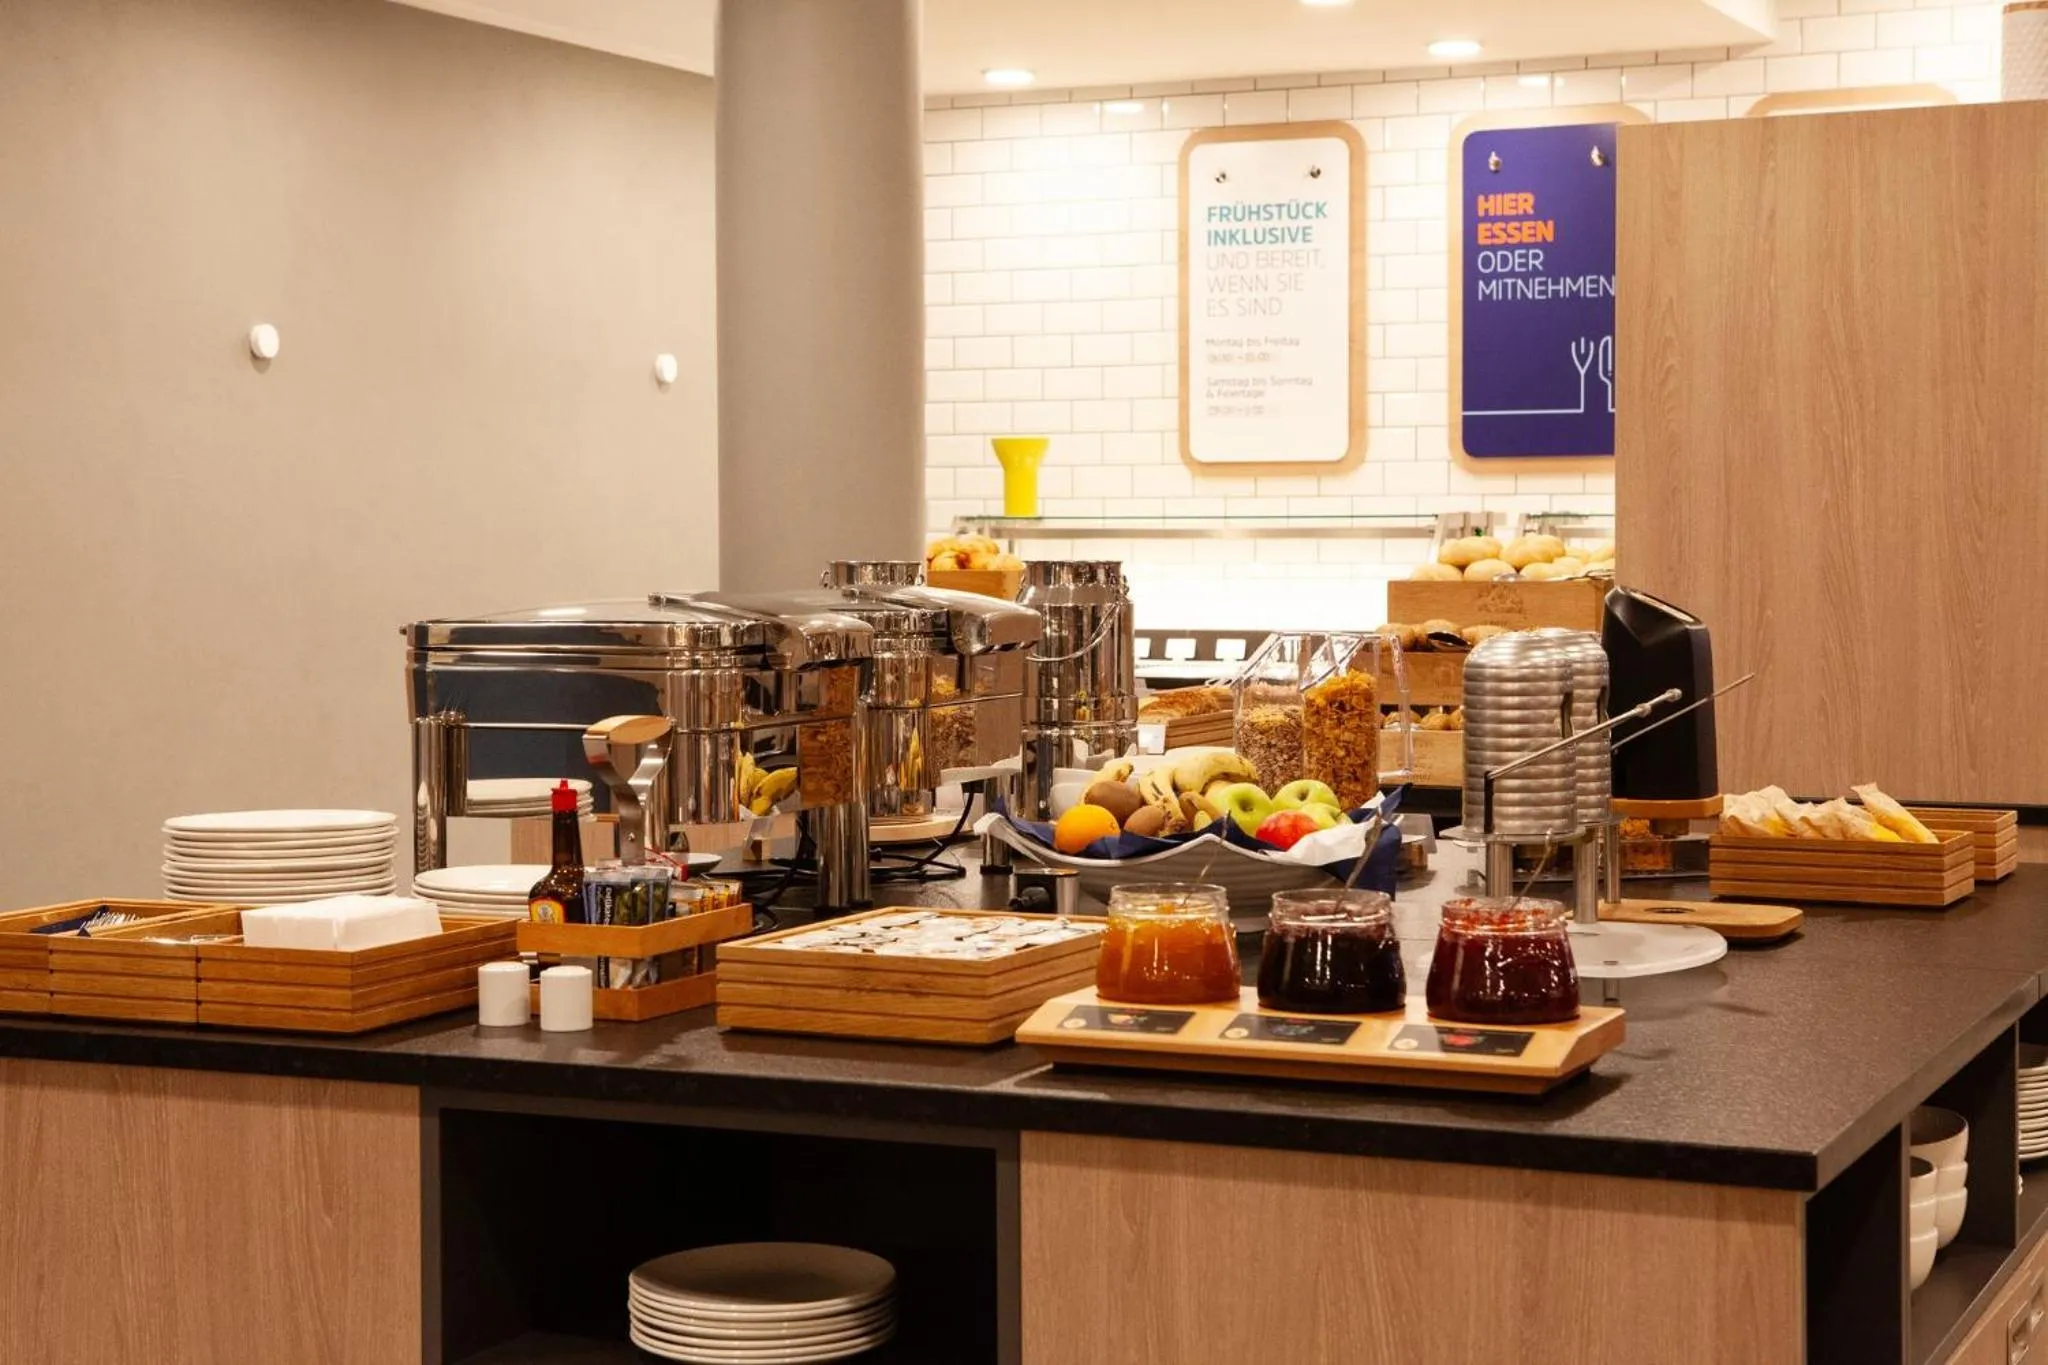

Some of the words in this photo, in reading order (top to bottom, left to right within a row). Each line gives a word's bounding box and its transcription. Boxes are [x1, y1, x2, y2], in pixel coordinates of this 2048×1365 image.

[1206, 199, 1328, 224] FRÜHSTÜCK
[1477, 192, 1535, 216] HIER
[1207, 226, 1314, 247] INKLUSIVE
[1477, 221, 1555, 245] ESSEN
[1206, 250, 1250, 271] UND
[1477, 249, 1545, 274] ODER
[1206, 275, 1269, 294] WENN
[1277, 272, 1305, 292] SIE
[1477, 275, 1616, 301] MITNEHMEN
[1206, 299, 1230, 318] ES
[1236, 296, 1284, 316] SIND
